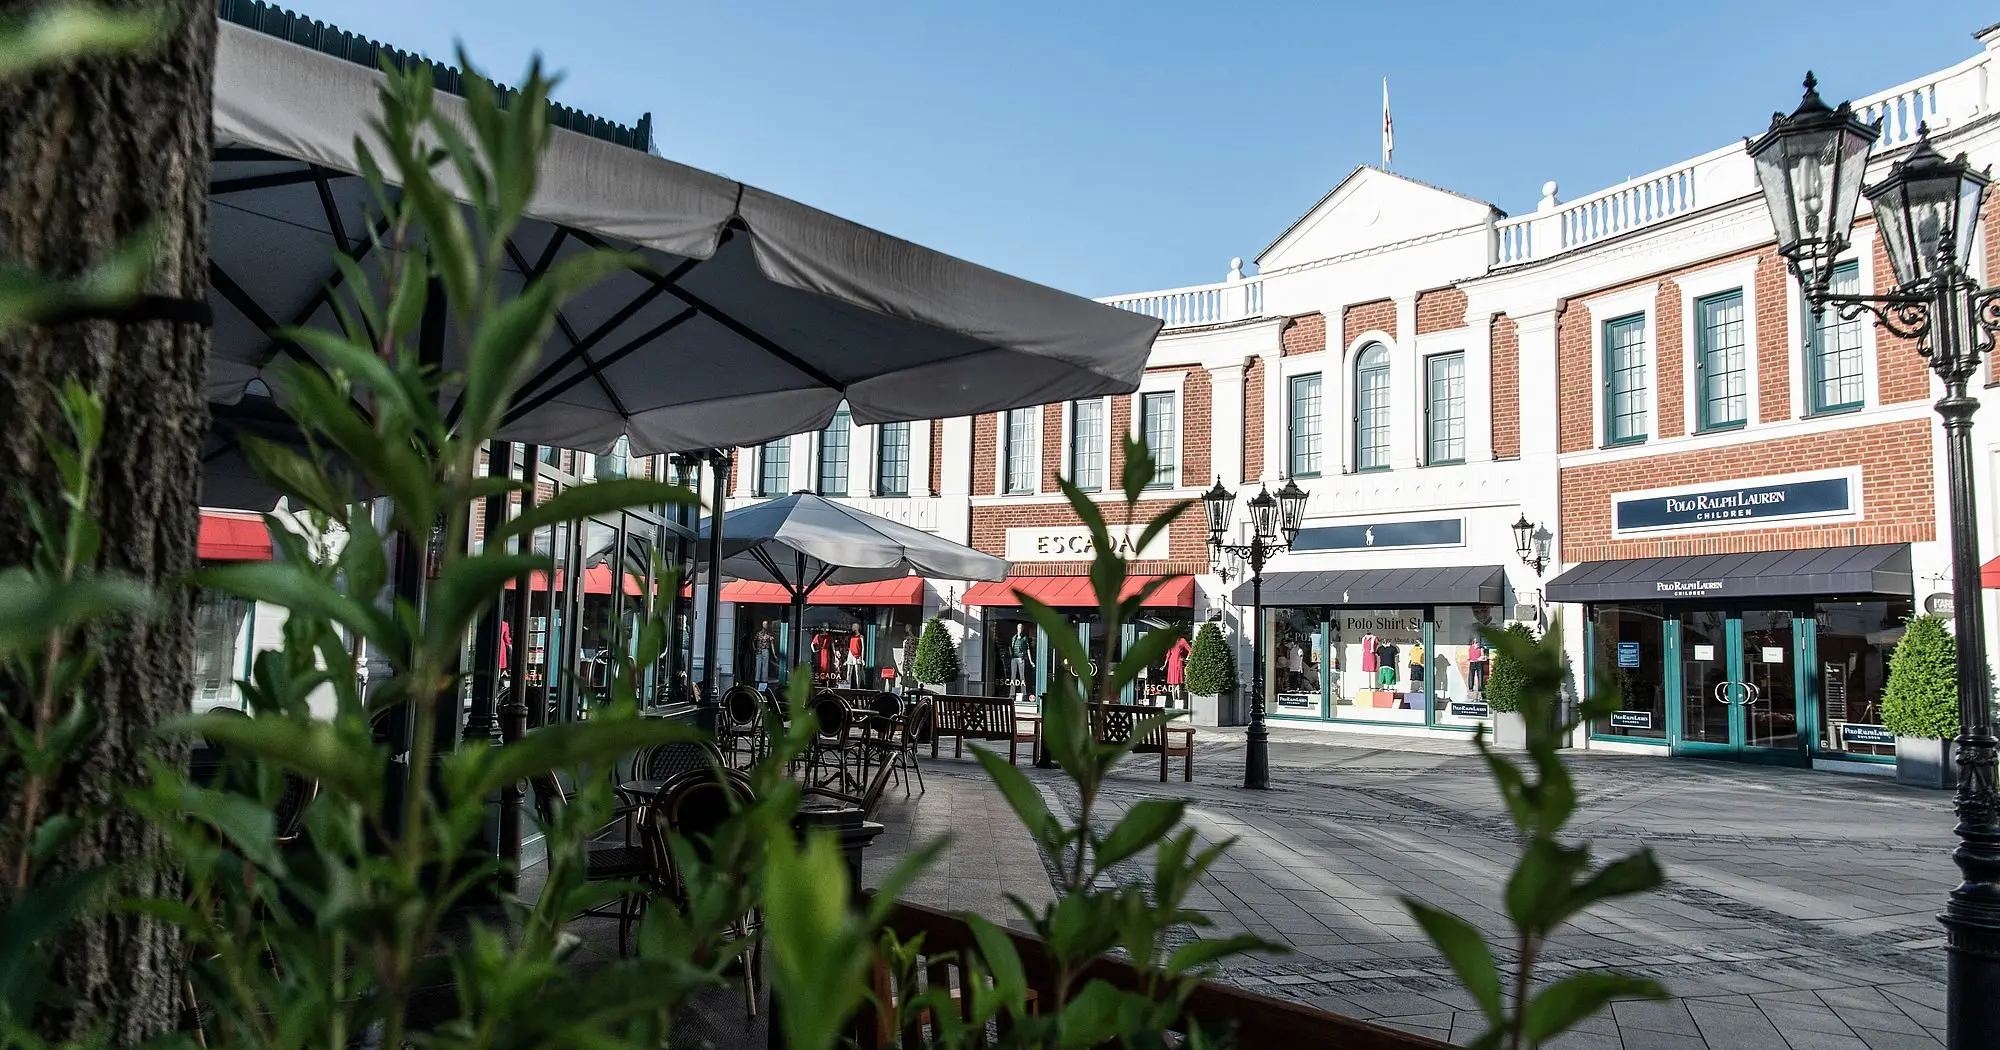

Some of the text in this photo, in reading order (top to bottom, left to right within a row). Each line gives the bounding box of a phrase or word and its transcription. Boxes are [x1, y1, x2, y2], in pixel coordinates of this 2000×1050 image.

[1666, 491, 1785, 513] POLO RALPH LAUREN
[1696, 508, 1752, 520] CHILDREN
[1656, 580, 1723, 591] POLO RALPH LAUREN
[1347, 617, 1443, 632] Polo Shirt Sty
[995, 678, 1026, 687] ESCADA
